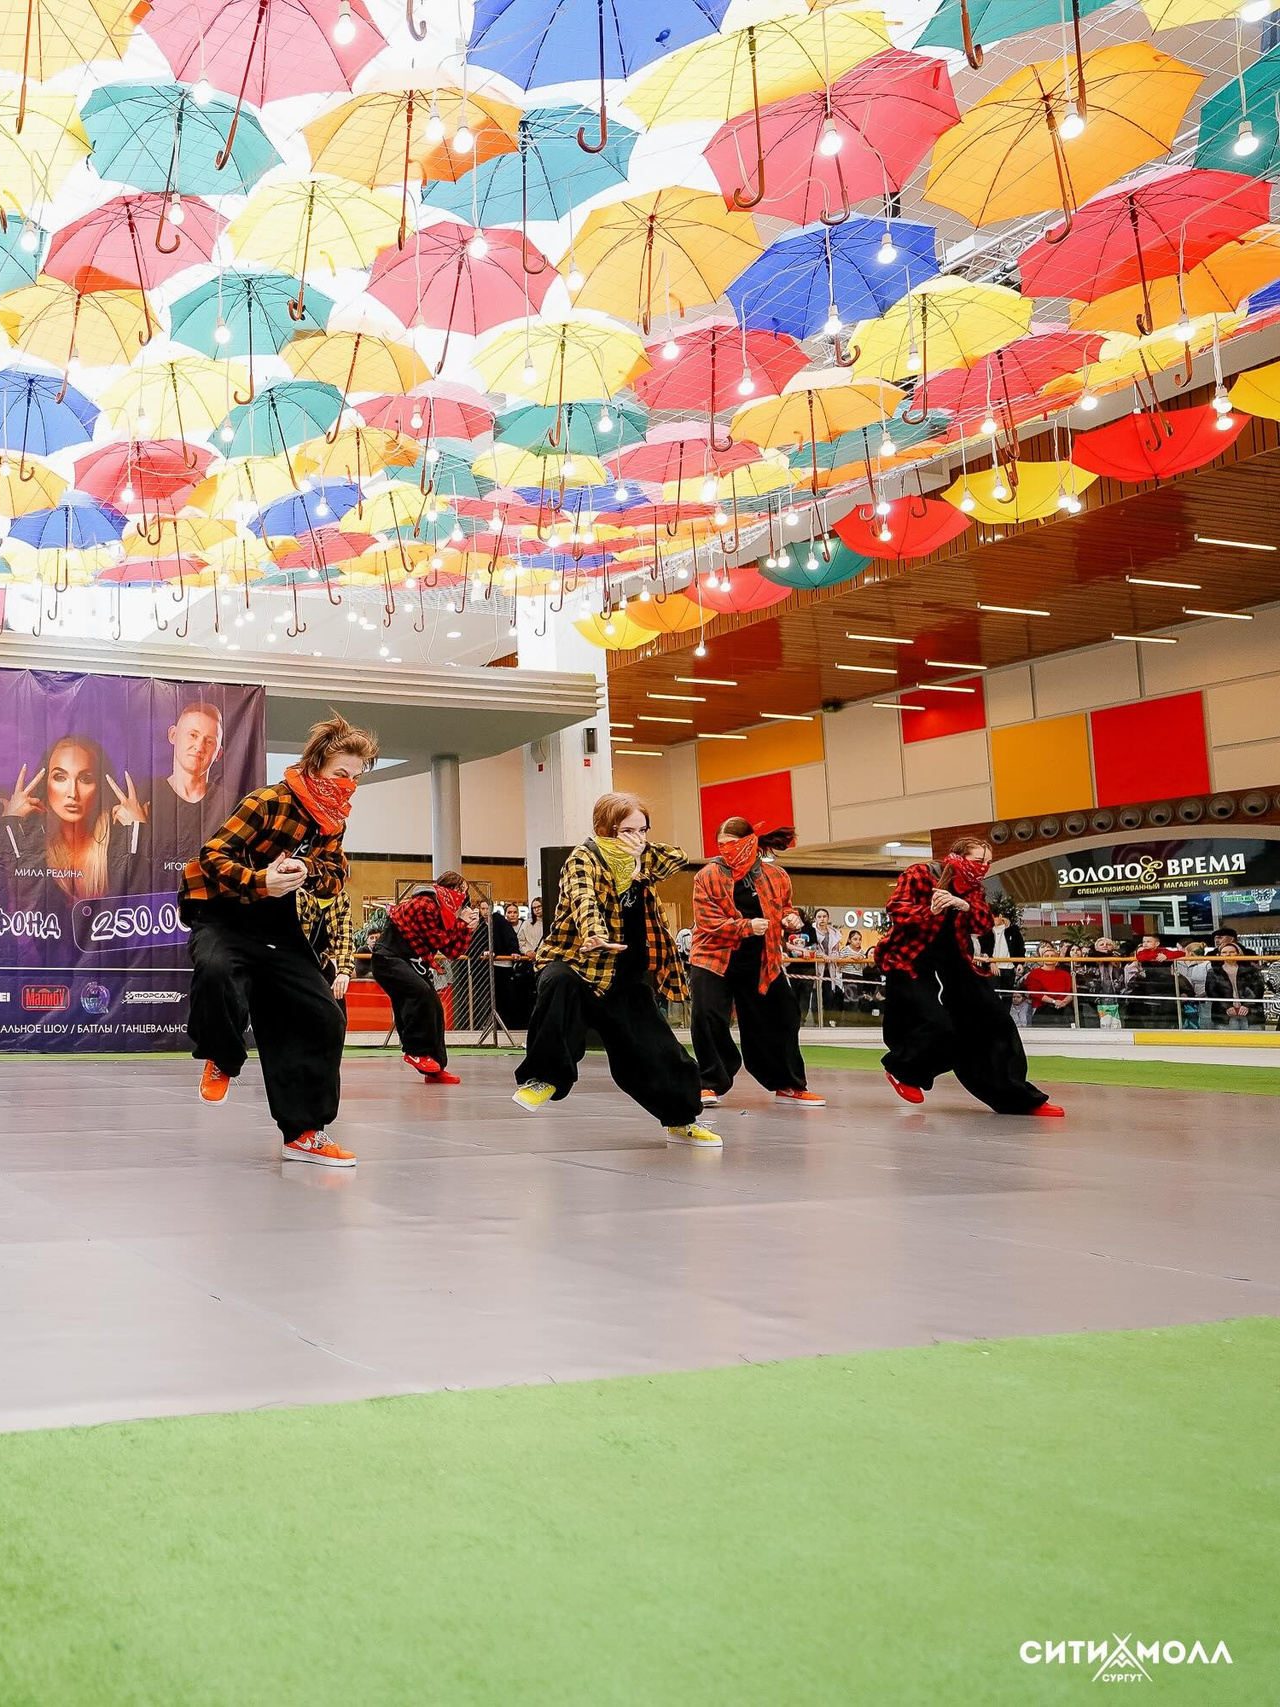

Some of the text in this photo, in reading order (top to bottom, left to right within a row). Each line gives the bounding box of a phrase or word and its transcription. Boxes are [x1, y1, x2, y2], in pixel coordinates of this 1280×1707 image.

[14, 868, 84, 878] МИЛА РЕДИНА
[164, 862, 188, 871] ИГОР
[1057, 864, 1143, 885] ЗОЛОТО
[1166, 852, 1246, 876] ВРЕМЯ
[1077, 877, 1229, 895] СПЕЦИАЛИЗИРОВАННЫЙ МАГАЗИН ЧАСОВ
[845, 908, 888, 928] O'ST
[43, 1024, 68, 1034] ШОУ
[77, 1024, 113, 1034] БАТТЛЫ
[121, 1024, 188, 1034] ТАНЦЕВАЛЬНО
